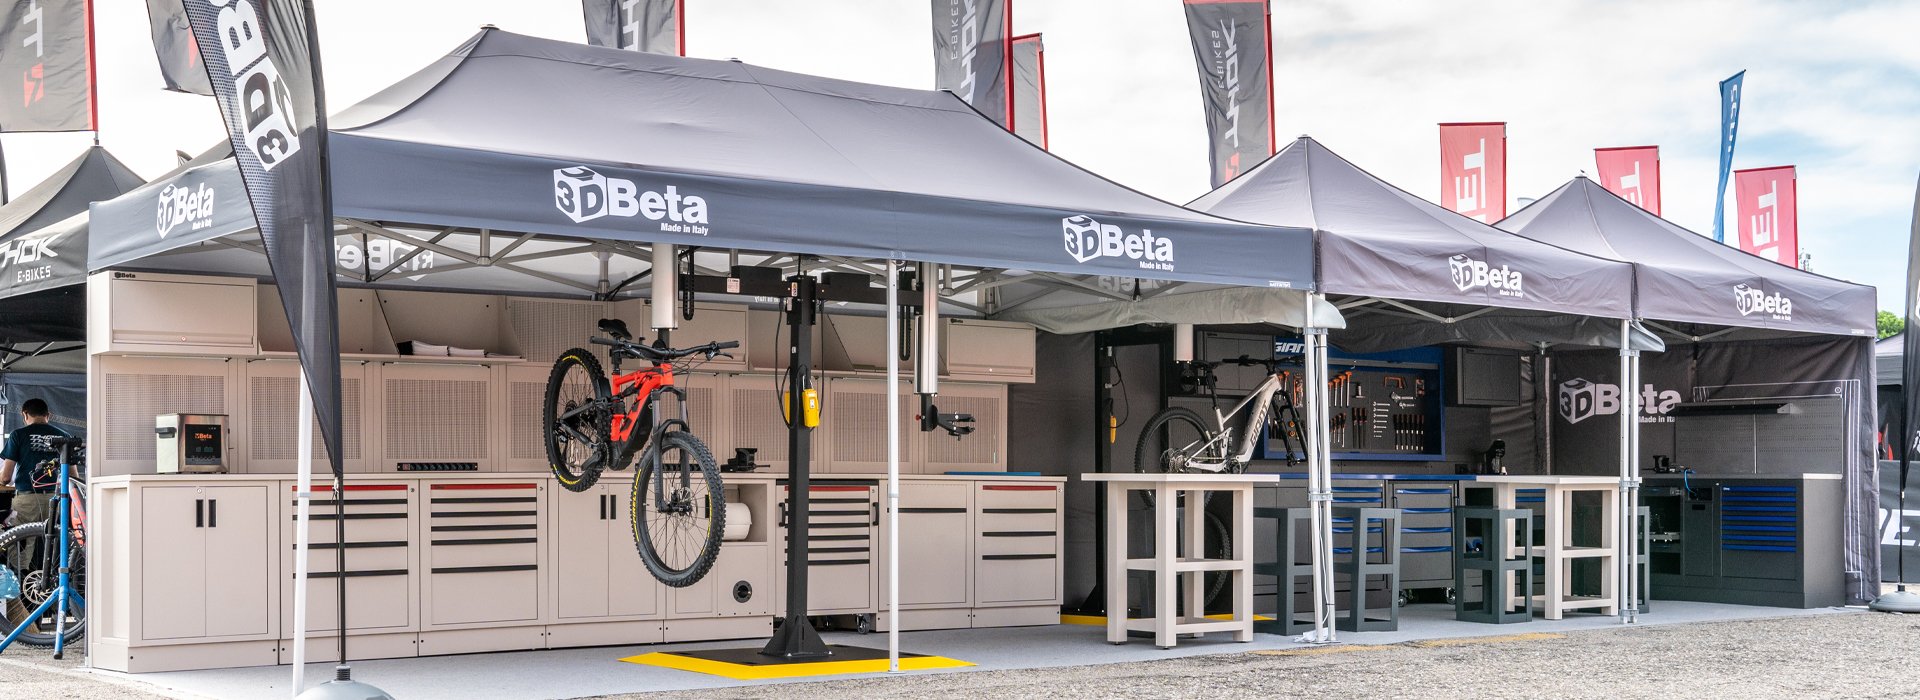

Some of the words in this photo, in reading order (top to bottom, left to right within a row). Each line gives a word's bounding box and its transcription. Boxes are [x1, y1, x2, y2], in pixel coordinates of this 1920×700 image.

[661, 223, 681, 232] Made
[683, 225, 690, 233] in
[692, 225, 708, 236] Italy
[1140, 261, 1154, 269] Made
[17, 265, 52, 282] E-BIKES
[1275, 342, 1305, 353] GIAN
